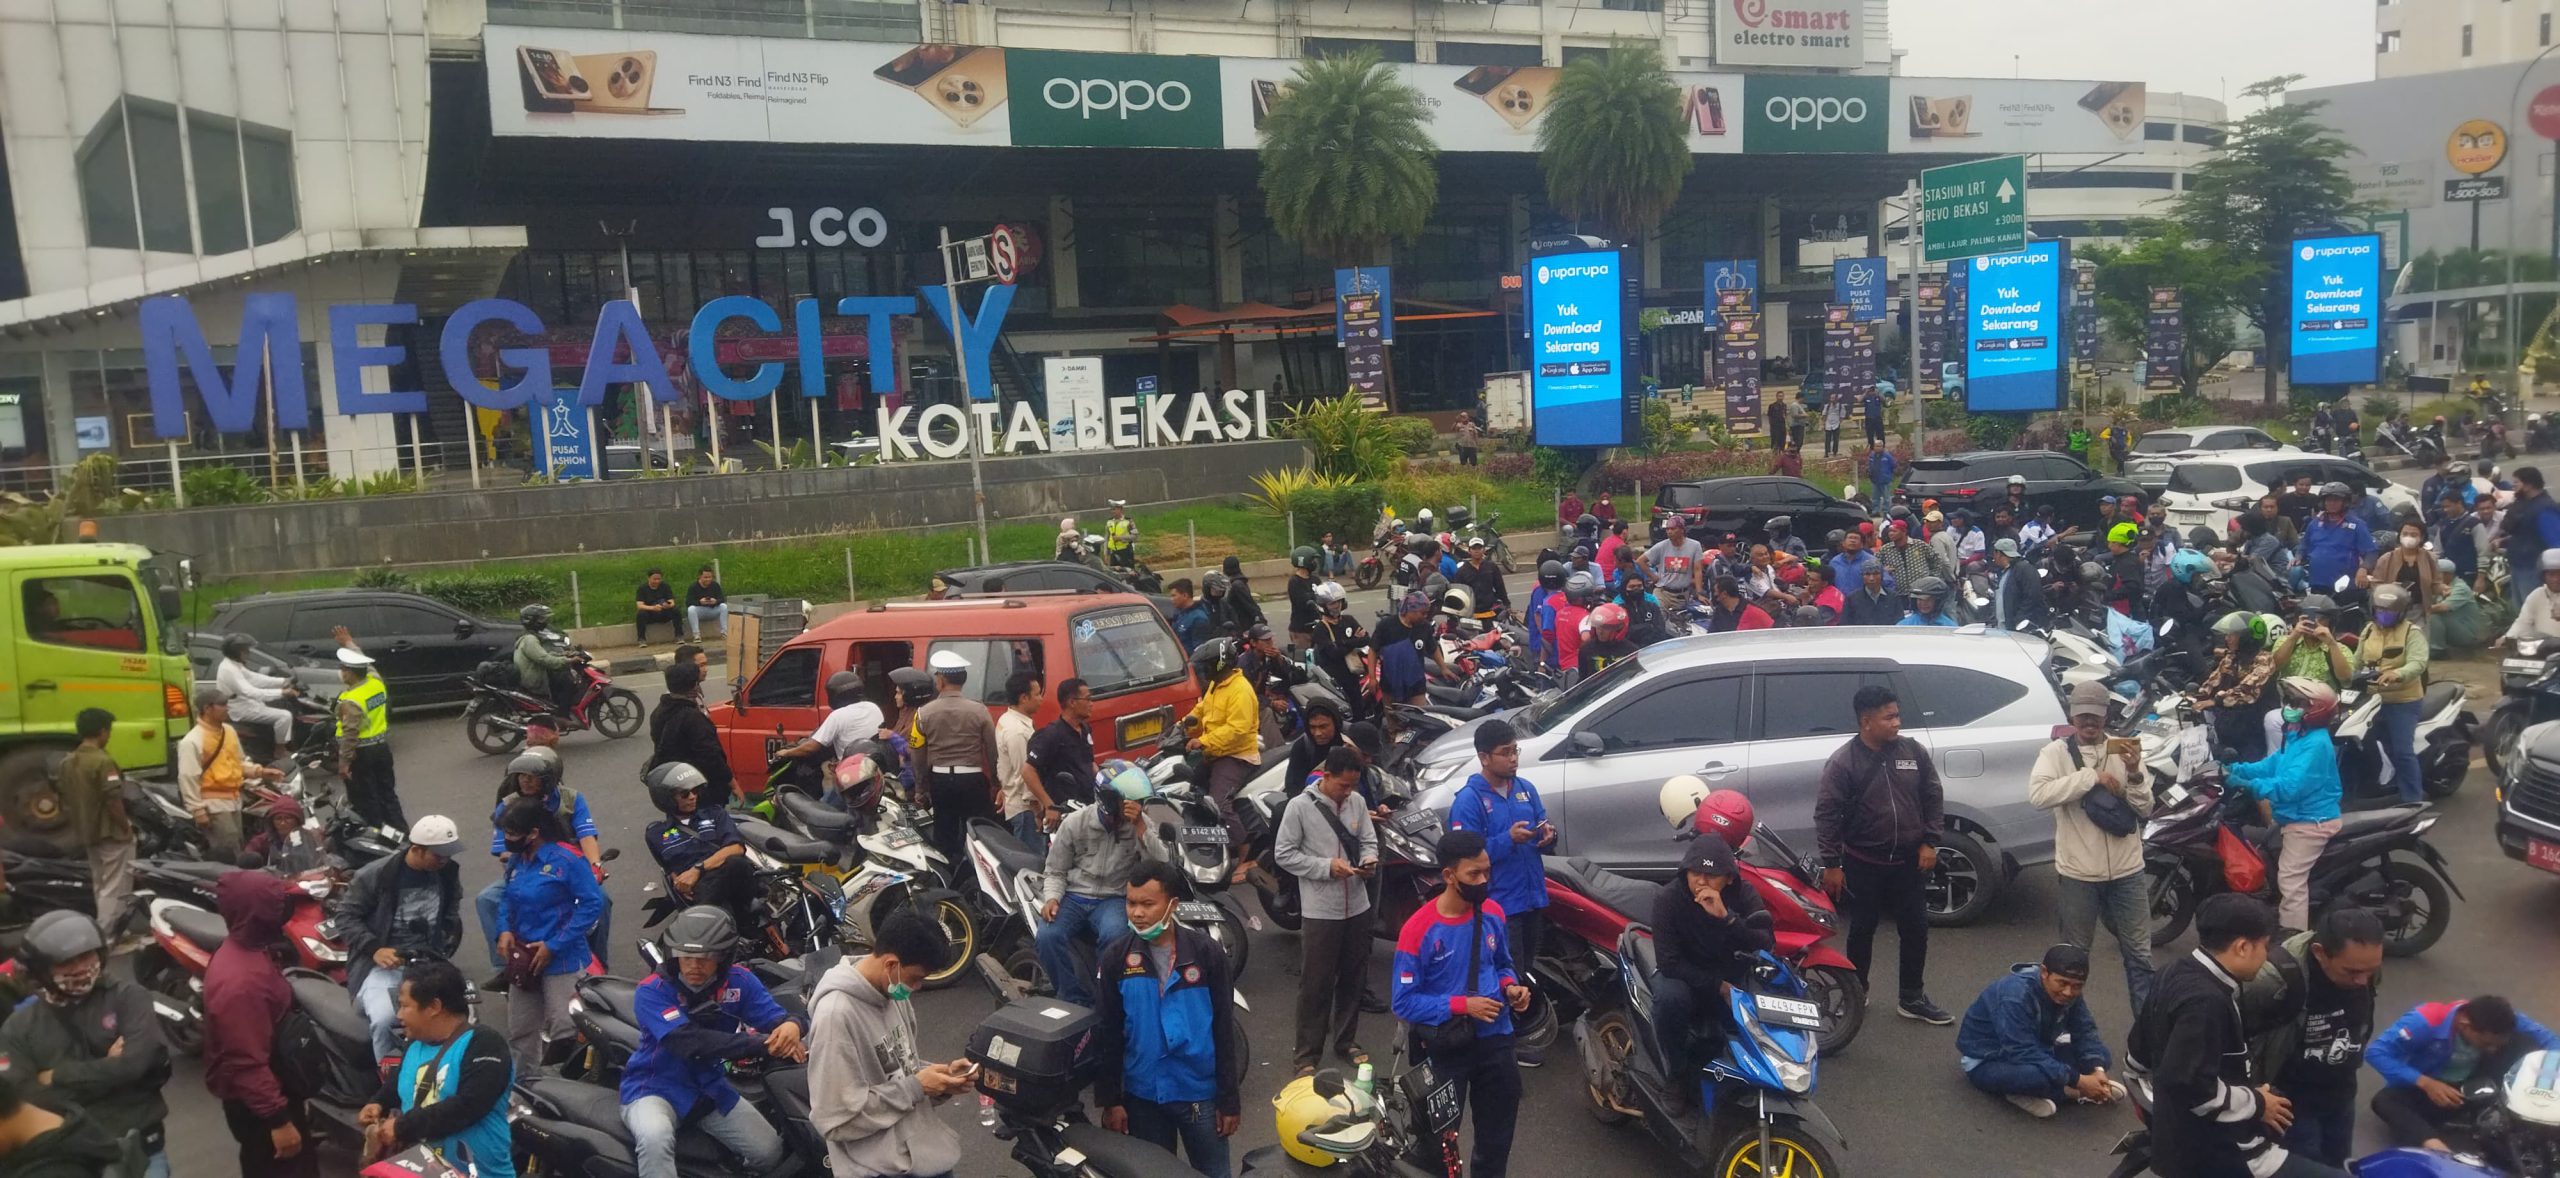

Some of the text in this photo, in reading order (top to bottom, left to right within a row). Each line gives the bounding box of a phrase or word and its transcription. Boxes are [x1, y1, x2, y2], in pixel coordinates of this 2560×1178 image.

[1770, 9, 1850, 30] smart
[1734, 29, 1850, 49] electro smart
[688, 74, 762, 88] Find N3 Find
[767, 71, 829, 87] Find N3 Flip
[1925, 180, 1986, 203] STASIUN LRT
[1925, 201, 1989, 223] REVO BEKASI
[755, 206, 888, 248] J.CO
[1927, 232, 2022, 252] AMBIL LAJUR PALING KANAN
[2315, 245, 2370, 258] ruparupa
[1990, 253, 2049, 267] ruparupa
[1550, 265, 1609, 280] ruparupa
[2322, 275, 2344, 286] Yuk
[1997, 287, 2020, 299] Yuk
[2305, 287, 2363, 300] Download
[1557, 304, 1579, 316] Yuk
[1980, 301, 2041, 316] Download
[2306, 303, 2361, 314] Sekarang
[1543, 320, 1602, 336] Download
[1982, 319, 2038, 332] Sekarang
[1545, 341, 1600, 354] Sekarang
[878, 390, 1267, 460] KOTA BEKASI
[552, 445, 579, 455] PUSAT
[552, 455, 586, 465] ASHION
[1190, 827, 1209, 836] 6142
[2529, 842, 2536, 856] B
[1759, 997, 1815, 1016] B 4494 FPK
